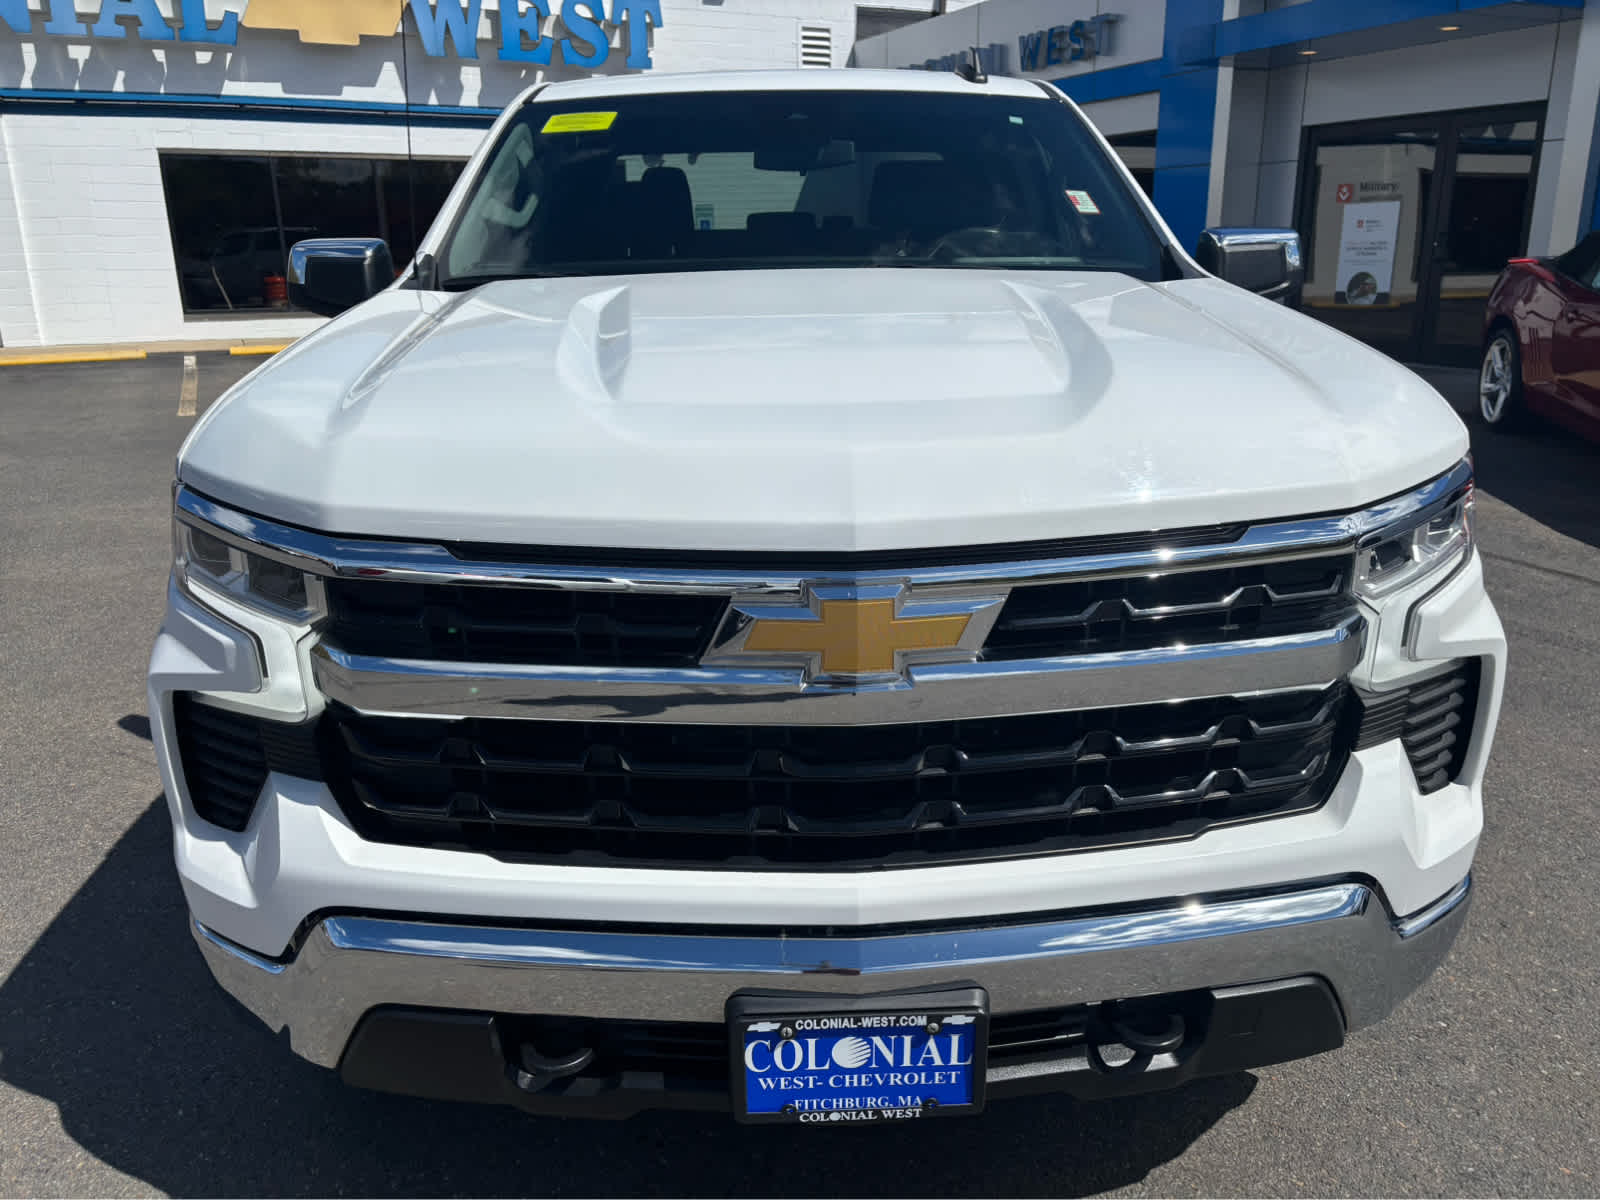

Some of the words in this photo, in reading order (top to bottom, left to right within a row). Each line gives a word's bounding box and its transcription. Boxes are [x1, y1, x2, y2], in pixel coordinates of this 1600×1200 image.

[410, 0, 664, 69] WEST
[1018, 13, 1126, 73] WEST
[795, 1015, 927, 1031] COLONIAL-WEST.COM
[744, 1033, 973, 1073] COLONIAL
[828, 1071, 961, 1088] CHEVROLET
[898, 1095, 922, 1106] MA
[799, 1110, 877, 1123] COLONIAL
[882, 1108, 922, 1119] WEST
